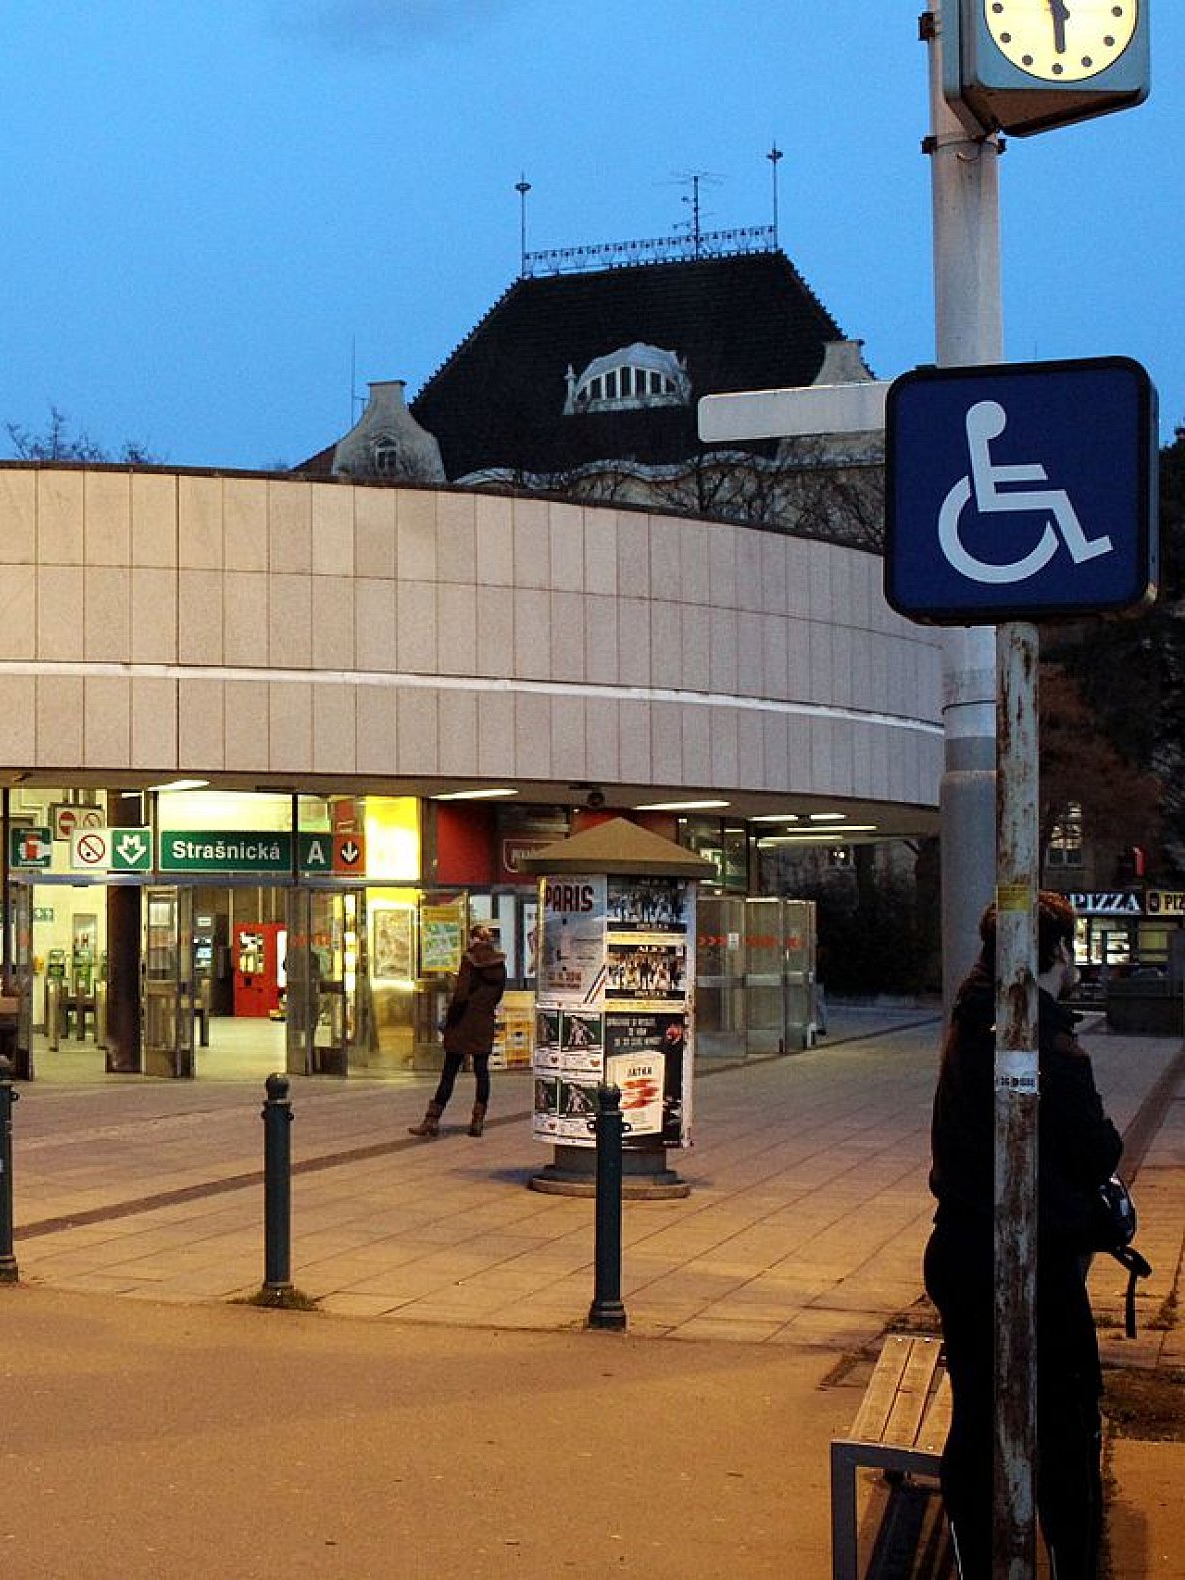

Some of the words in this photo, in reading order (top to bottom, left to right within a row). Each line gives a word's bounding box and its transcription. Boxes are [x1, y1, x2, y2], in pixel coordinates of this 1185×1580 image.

[171, 840, 281, 861] Strašnická
[306, 840, 327, 864] A
[545, 884, 594, 912] PARIS
[1069, 893, 1141, 911] PIZZA
